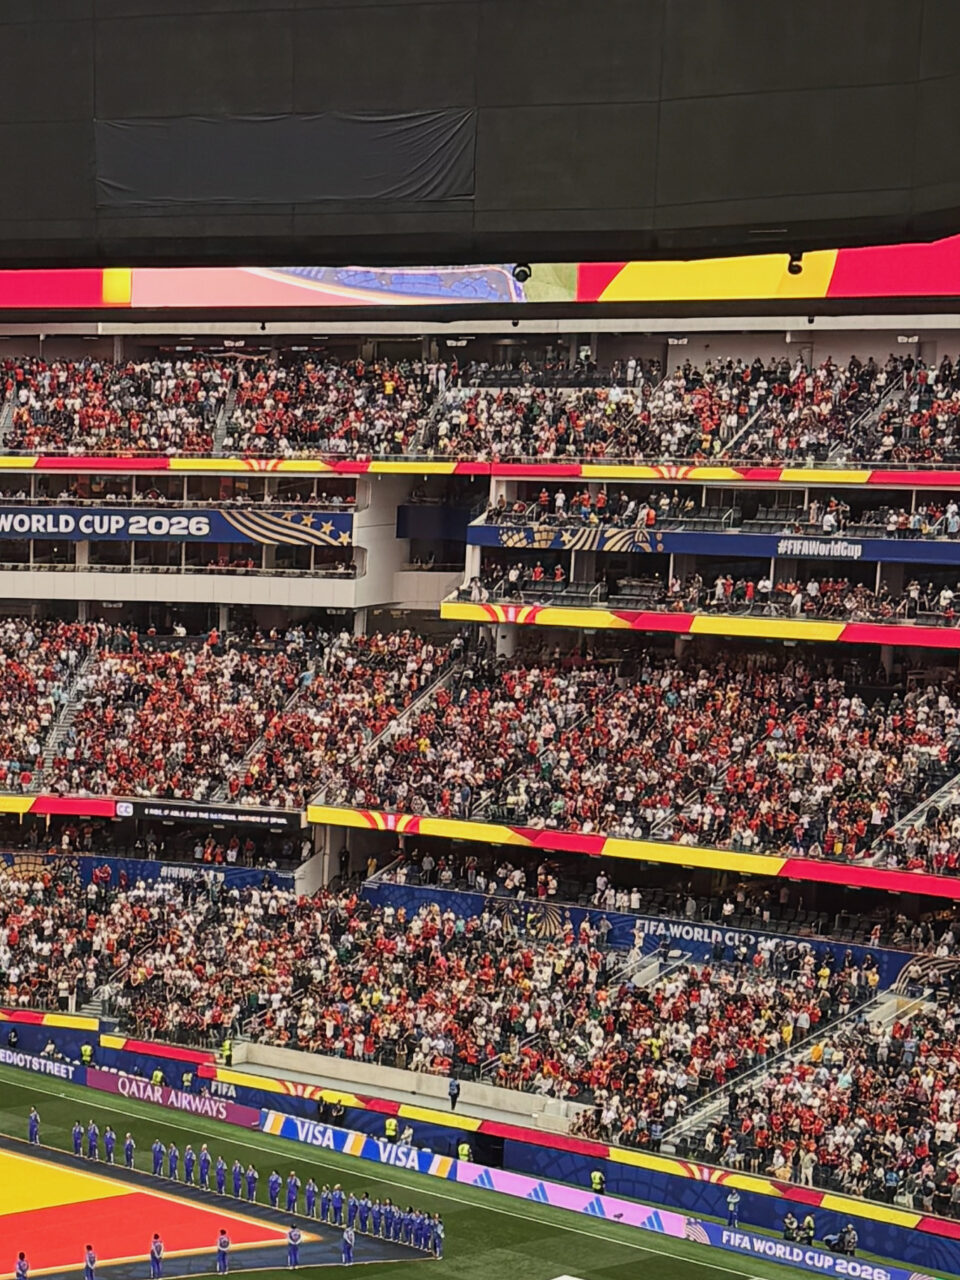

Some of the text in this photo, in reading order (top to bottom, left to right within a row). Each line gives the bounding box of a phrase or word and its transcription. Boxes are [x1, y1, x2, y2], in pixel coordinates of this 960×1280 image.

[79, 515, 125, 534] CUP
[128, 516, 210, 535] 2026
[777, 539, 862, 560] #FIFAWorldCup
[669, 923, 722, 944] WORLD
[118, 1078, 227, 1120] QATAR AIRWAYS
[211, 1081, 237, 1098] FIFA
[294, 1118, 335, 1150] VISA
[374, 1140, 420, 1171] VISA
[721, 1230, 751, 1251] FIFA
[753, 1238, 803, 1263] WORLD
[805, 1249, 834, 1269] CUP
